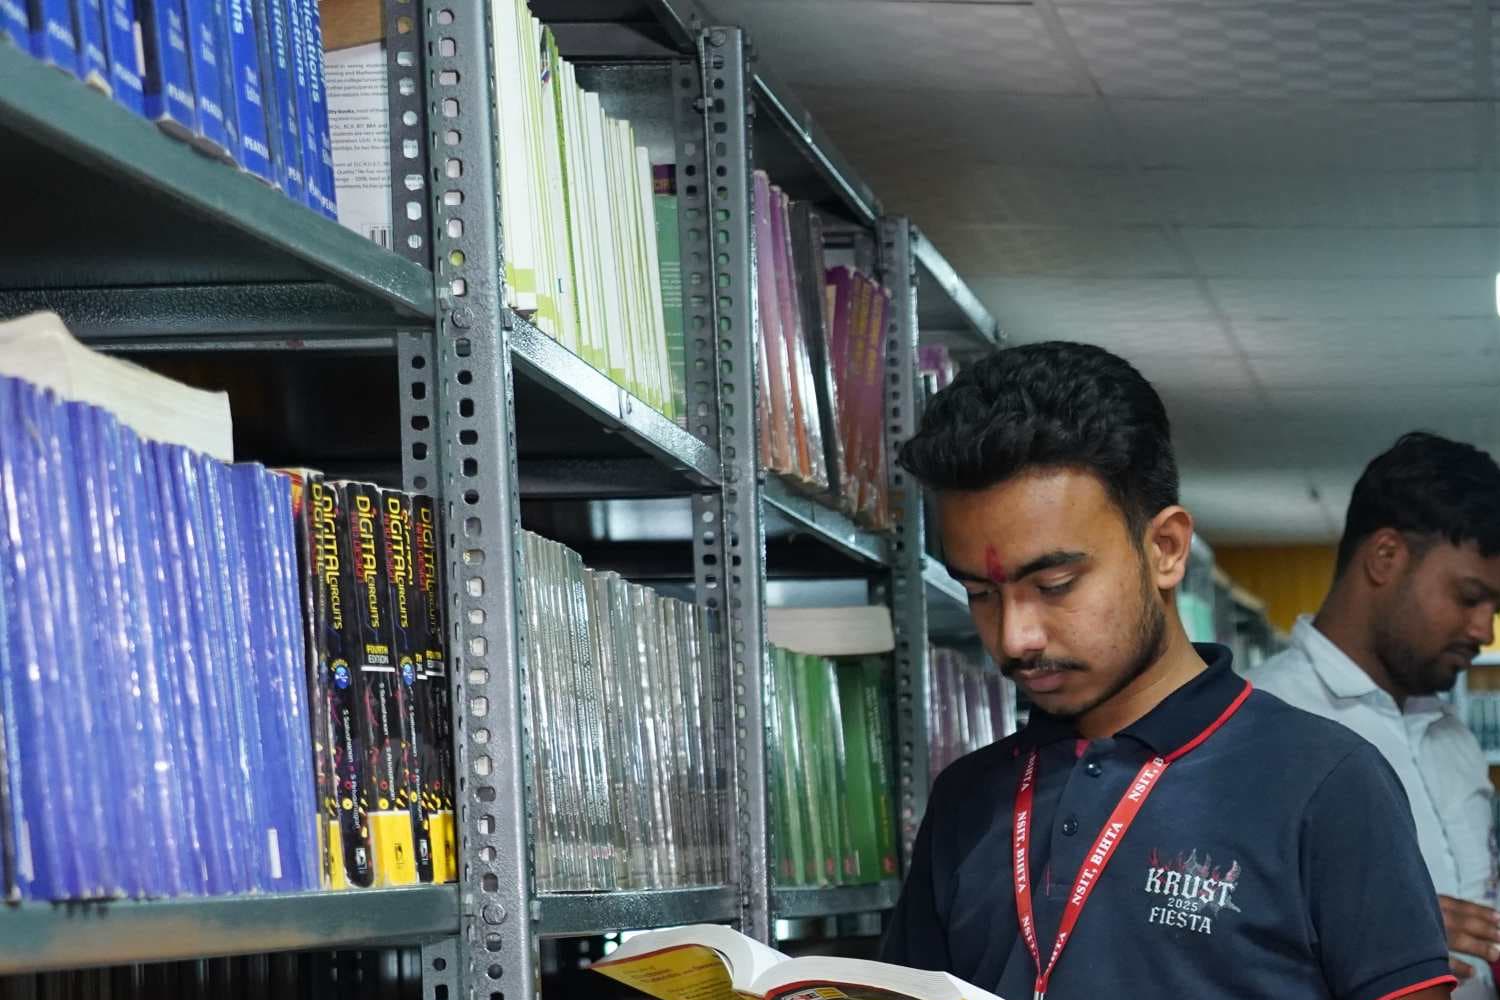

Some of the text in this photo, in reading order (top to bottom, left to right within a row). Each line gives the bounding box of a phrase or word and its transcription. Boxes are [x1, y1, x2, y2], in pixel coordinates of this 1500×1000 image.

[356, 495, 380, 629] DIGITAL CIRCUITS
[388, 497, 406, 583] DIGITAL
[420, 507, 435, 591] DIGITAL
[1127, 768, 1159, 802] NSIT,
[1072, 822, 1124, 906] NSIT, BIHTA
[1144, 866, 1237, 908] KRUST
[1148, 906, 1213, 935] FIESTA
[1167, 896, 1199, 913] 2025
